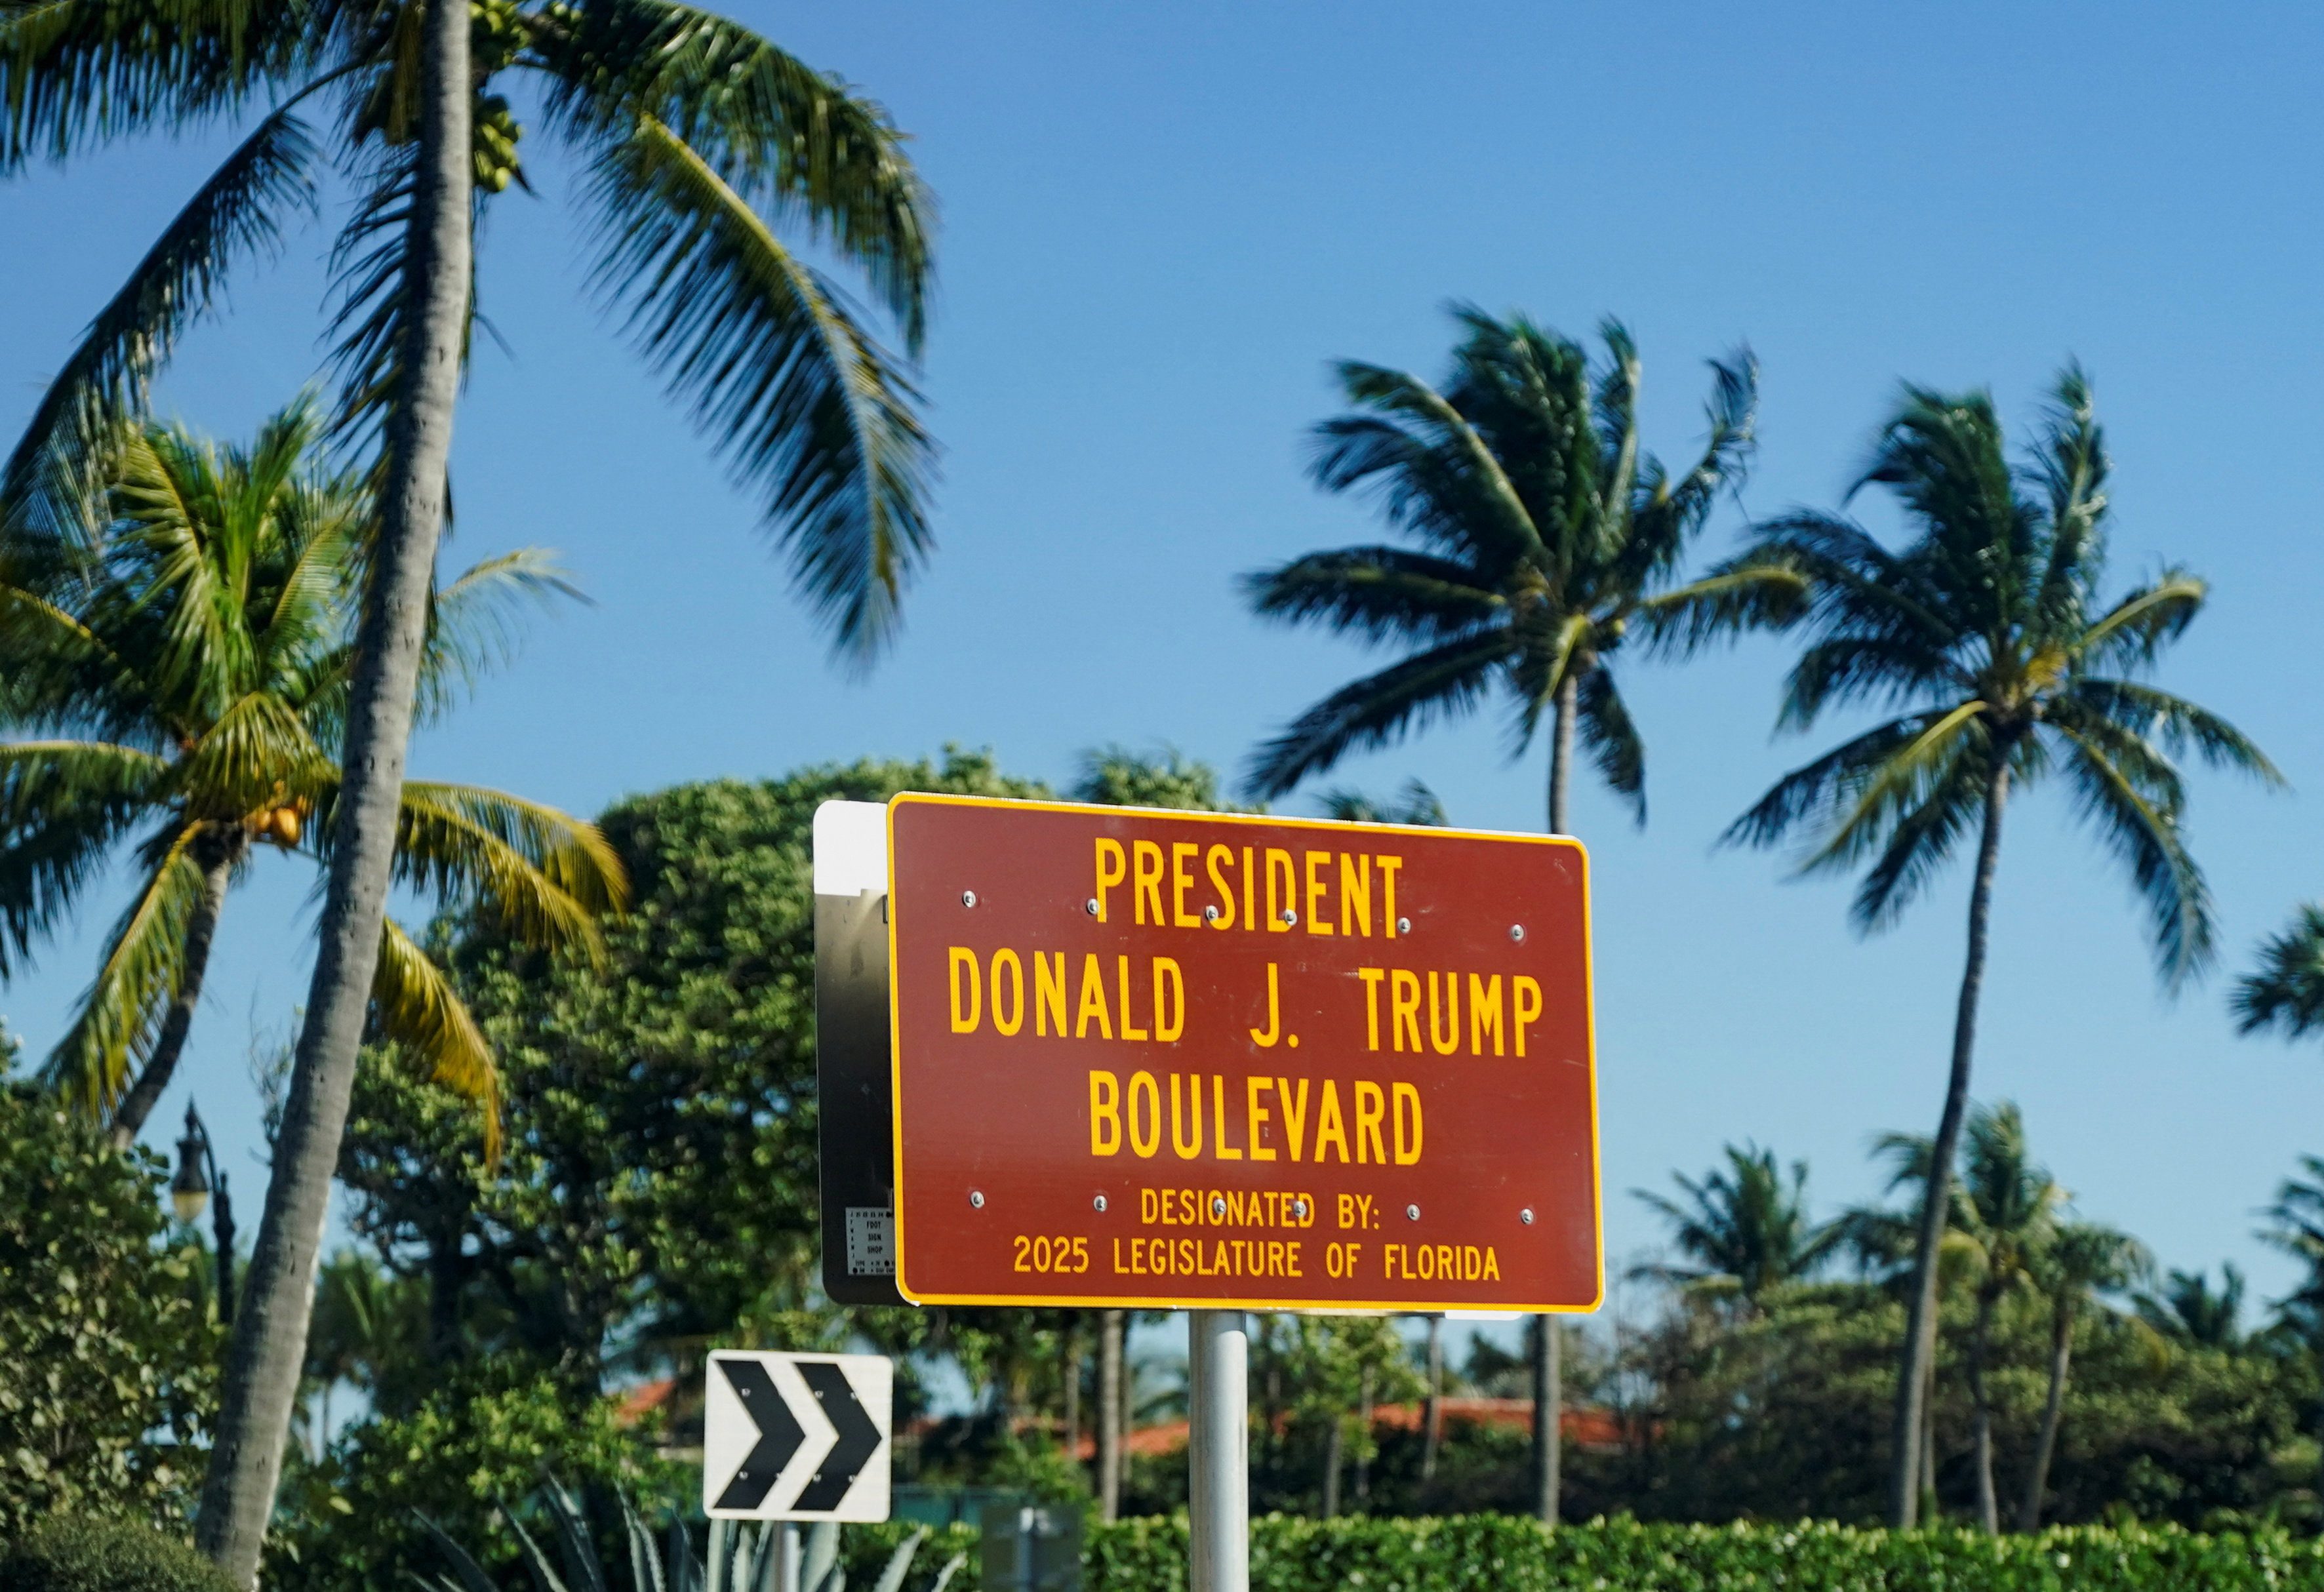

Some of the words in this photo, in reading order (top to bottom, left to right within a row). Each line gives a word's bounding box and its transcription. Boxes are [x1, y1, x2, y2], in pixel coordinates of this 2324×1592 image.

[1094, 837, 1403, 940] PRESIDENT
[948, 945, 1186, 1043] DONALD
[1249, 962, 1300, 1048] J.
[1357, 966, 1544, 1058] TRUMP
[1088, 1069, 1424, 1166] BOULEVARD
[1013, 1235, 1090, 1273] 2025
[1113, 1238, 1303, 1277] LEGISLATURE
[1325, 1242, 1362, 1279] OF
[1384, 1244, 1501, 1281] FLORIDA
[1140, 1188, 1315, 1228] DESIGNATED
[1337, 1193, 1380, 1231] BY:
